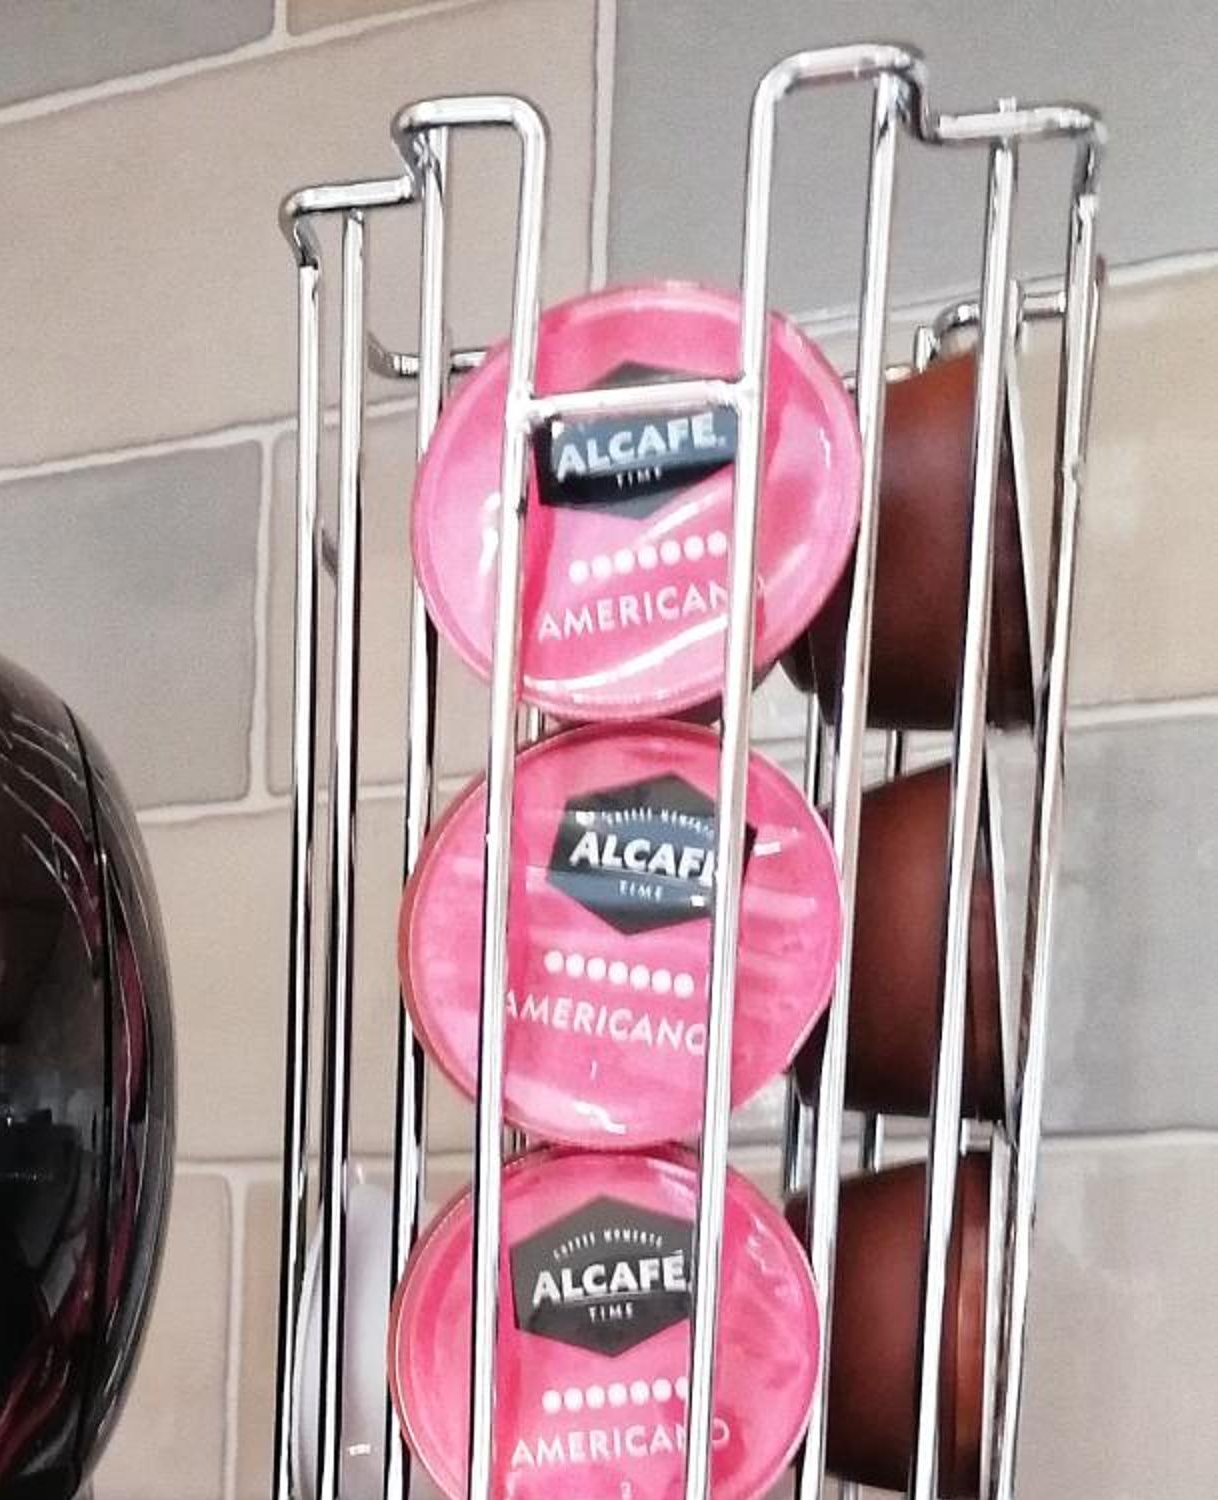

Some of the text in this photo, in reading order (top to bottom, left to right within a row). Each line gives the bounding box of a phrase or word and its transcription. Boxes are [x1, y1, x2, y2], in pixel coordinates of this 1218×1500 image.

[617, 466, 662, 491] TIME
[537, 580, 730, 644] AMERICAN
[619, 879, 664, 902] TIME
[589, 1301, 633, 1324] TIME
